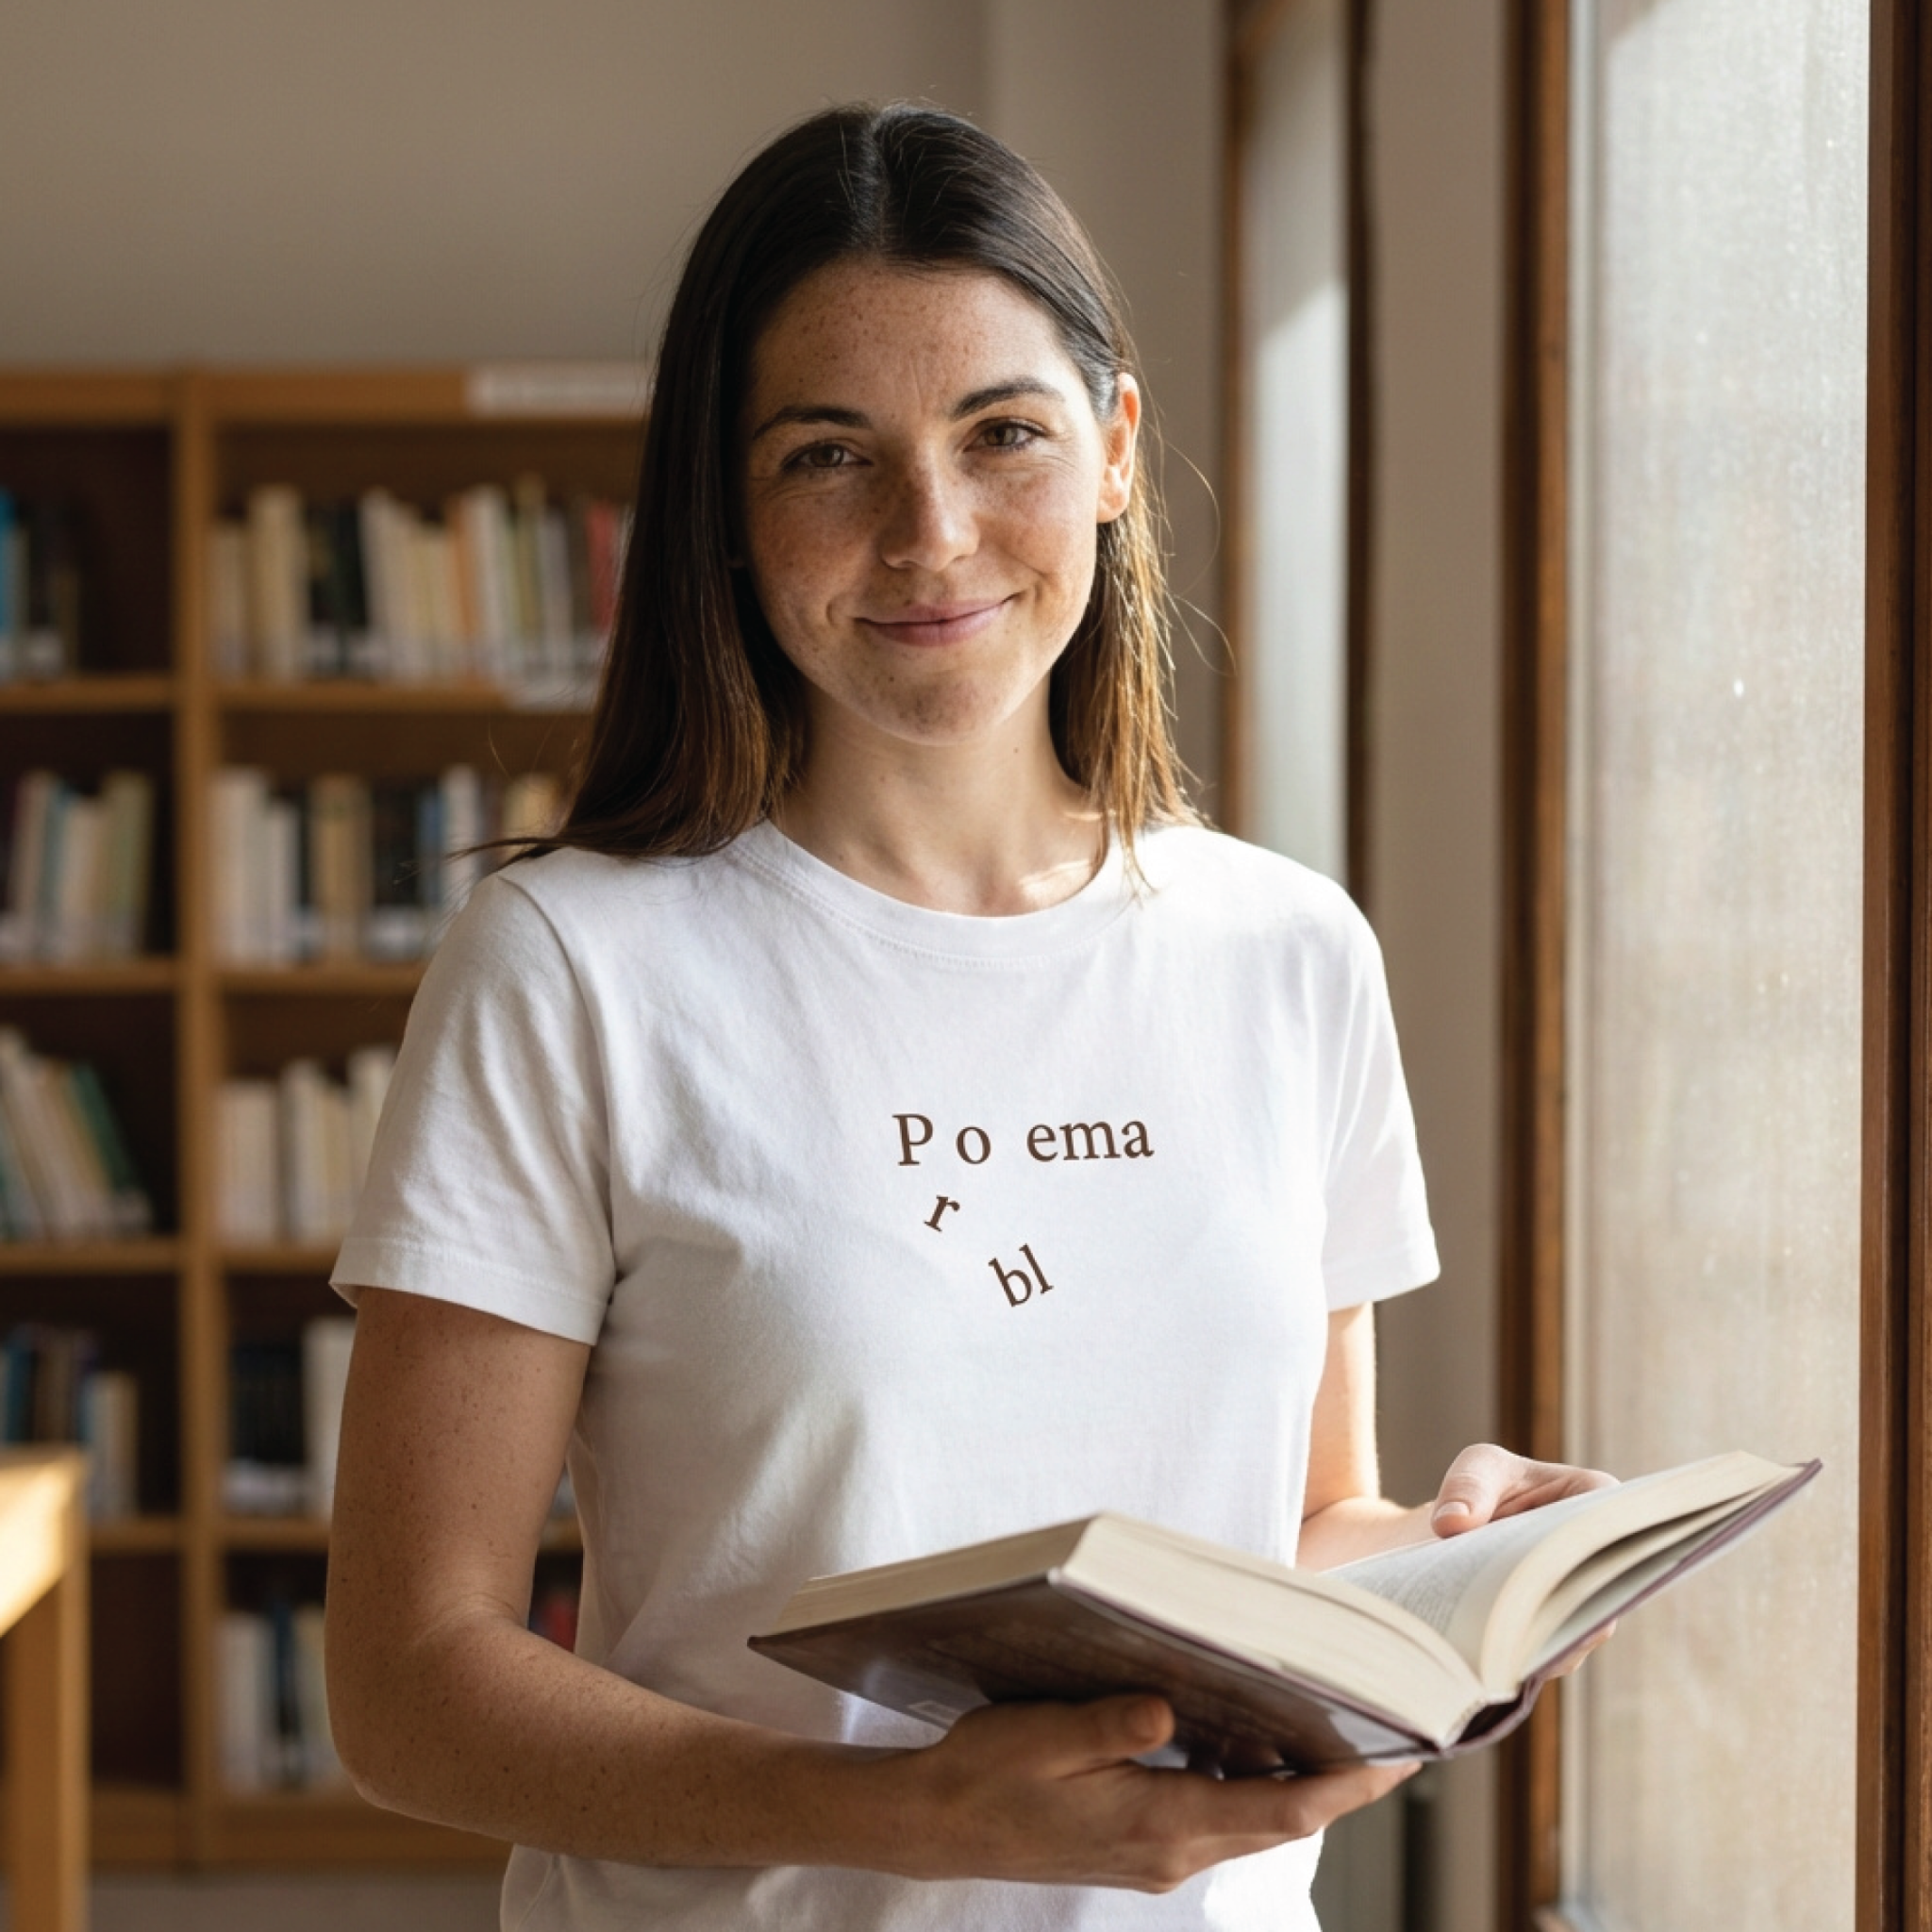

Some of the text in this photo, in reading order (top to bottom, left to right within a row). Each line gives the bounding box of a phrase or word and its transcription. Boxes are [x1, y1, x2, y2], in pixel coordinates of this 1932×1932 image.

[891, 1113, 934, 1166] P
[1026, 1121, 1155, 1162] ema
[924, 1195, 961, 1232] r
[988, 1243, 1055, 1307] bl
